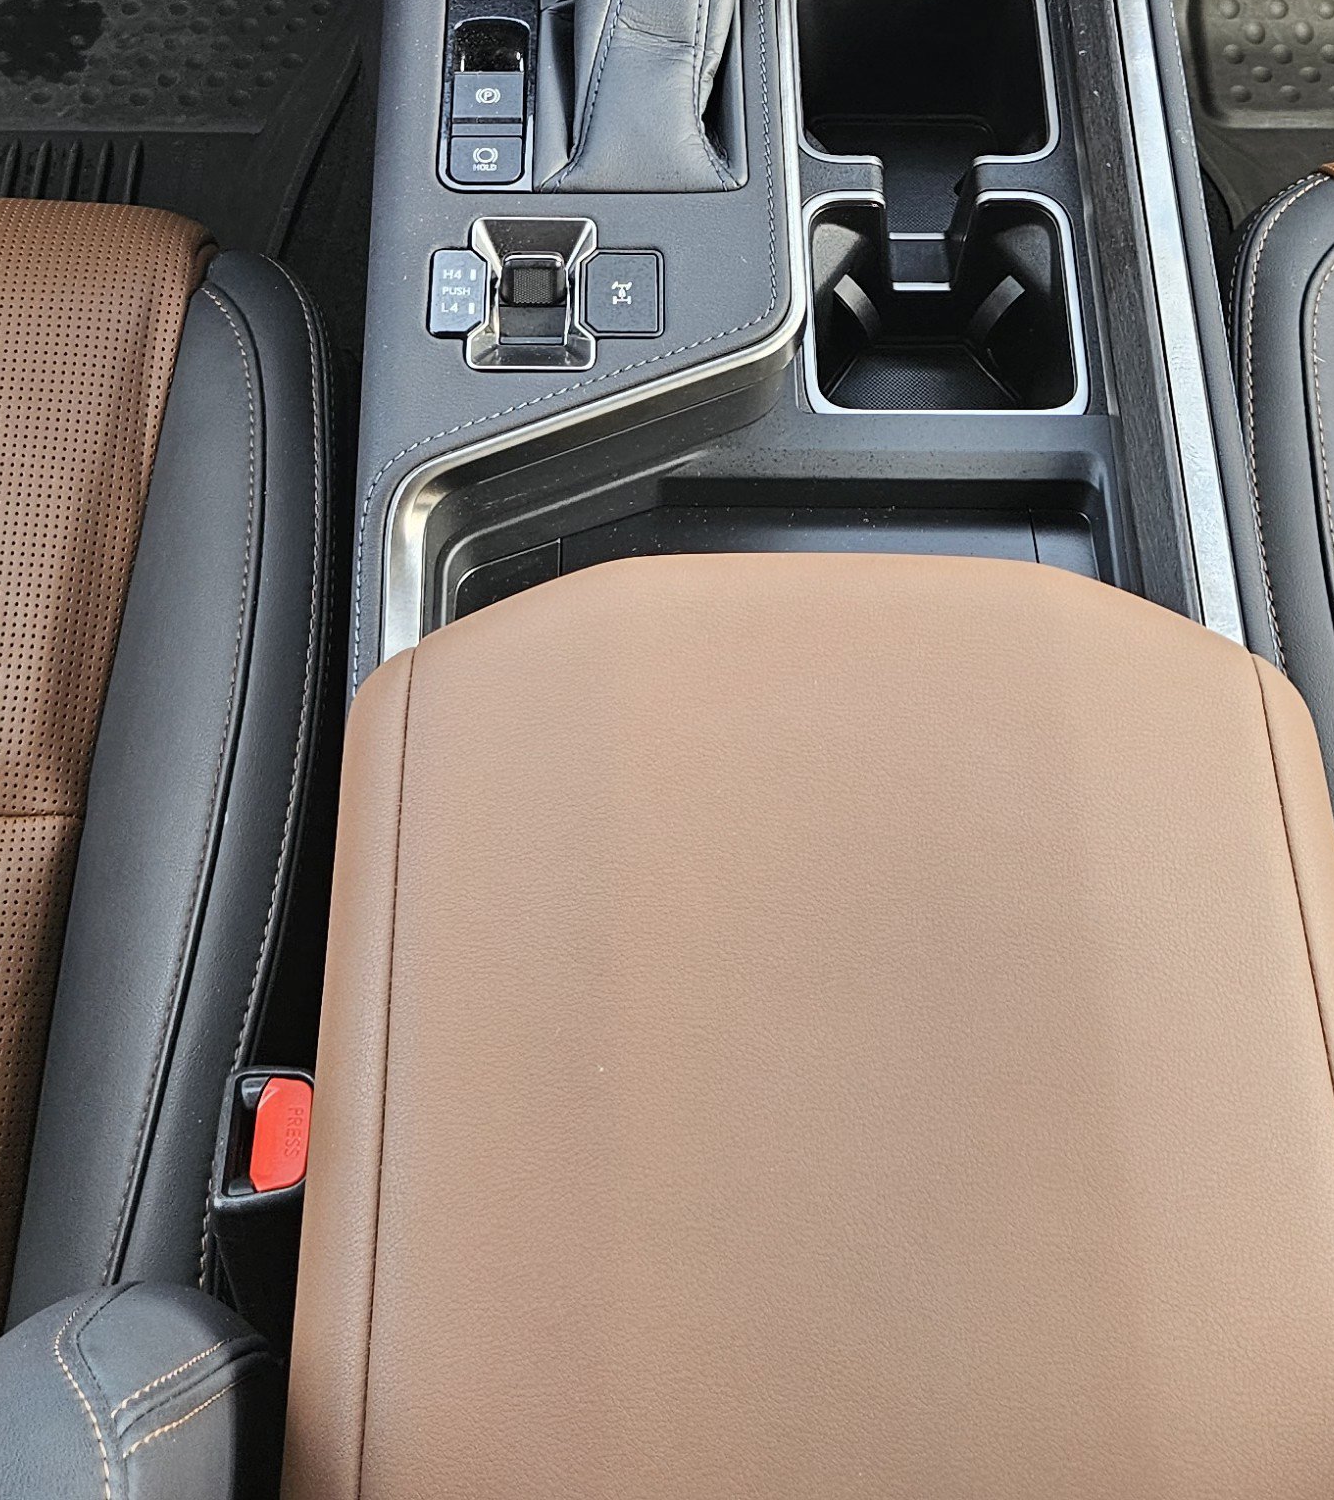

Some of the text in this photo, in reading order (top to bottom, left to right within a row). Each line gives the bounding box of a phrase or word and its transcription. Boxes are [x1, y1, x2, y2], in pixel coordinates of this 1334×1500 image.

[443, 269, 462, 280] H4
[442, 286, 470, 296] PUSH
[441, 303, 459, 313] L4
[284, 1107, 304, 1157] PRESS
